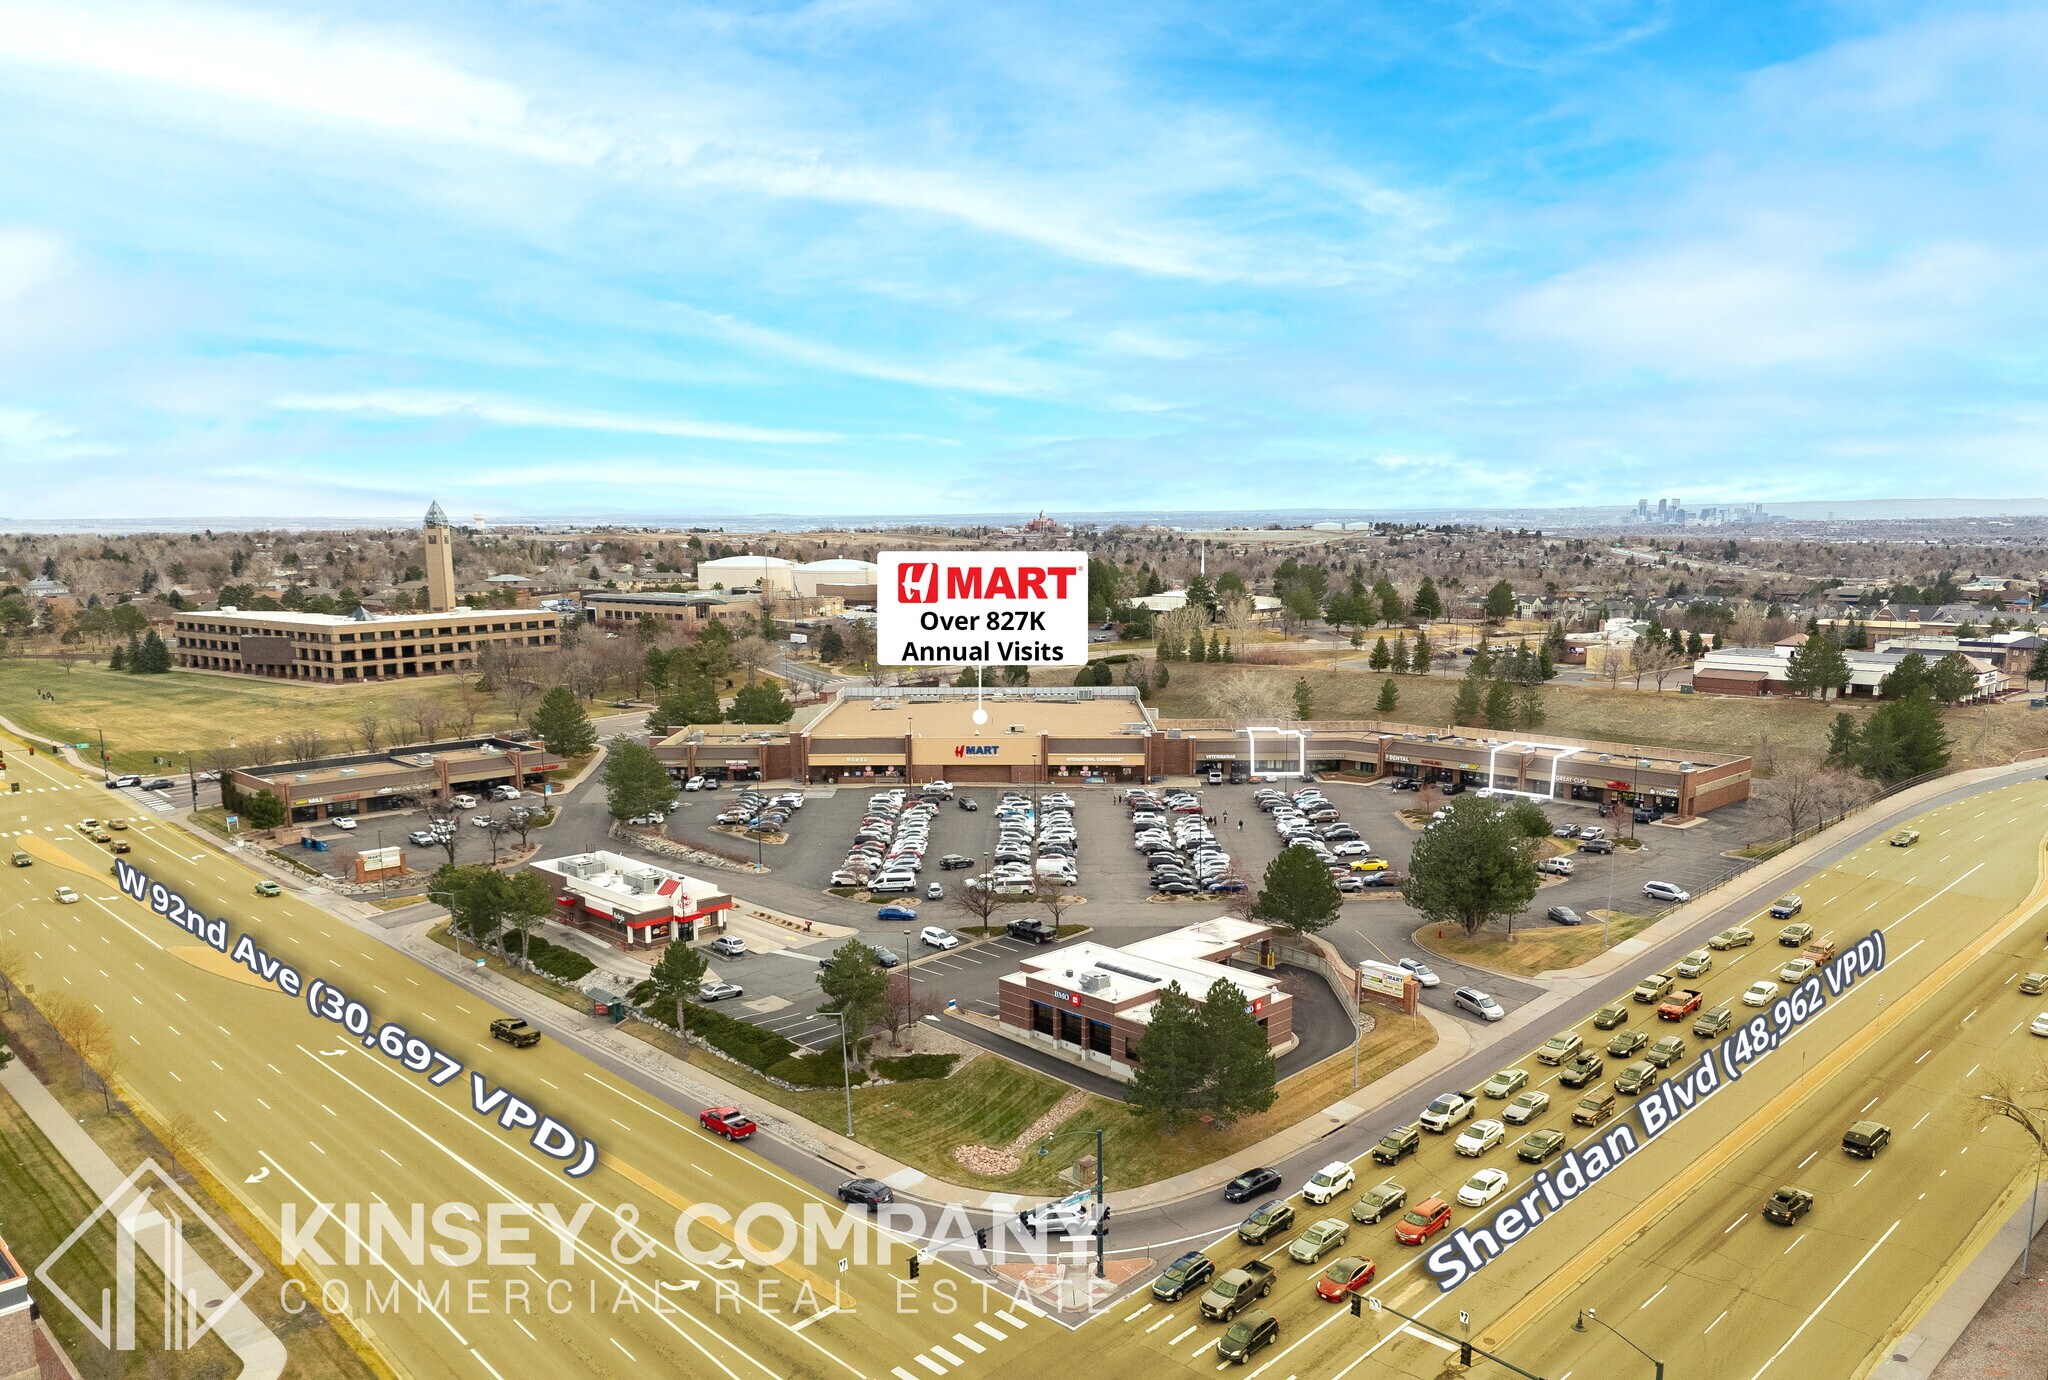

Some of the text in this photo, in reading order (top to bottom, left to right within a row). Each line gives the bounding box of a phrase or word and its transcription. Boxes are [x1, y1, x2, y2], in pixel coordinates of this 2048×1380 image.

[965, 745, 1000, 755] MART
[1389, 754, 1410, 763] DENTAL
[1555, 775, 1588, 785] GREAT CLIPS
[1054, 990, 1070, 1001] BMO
